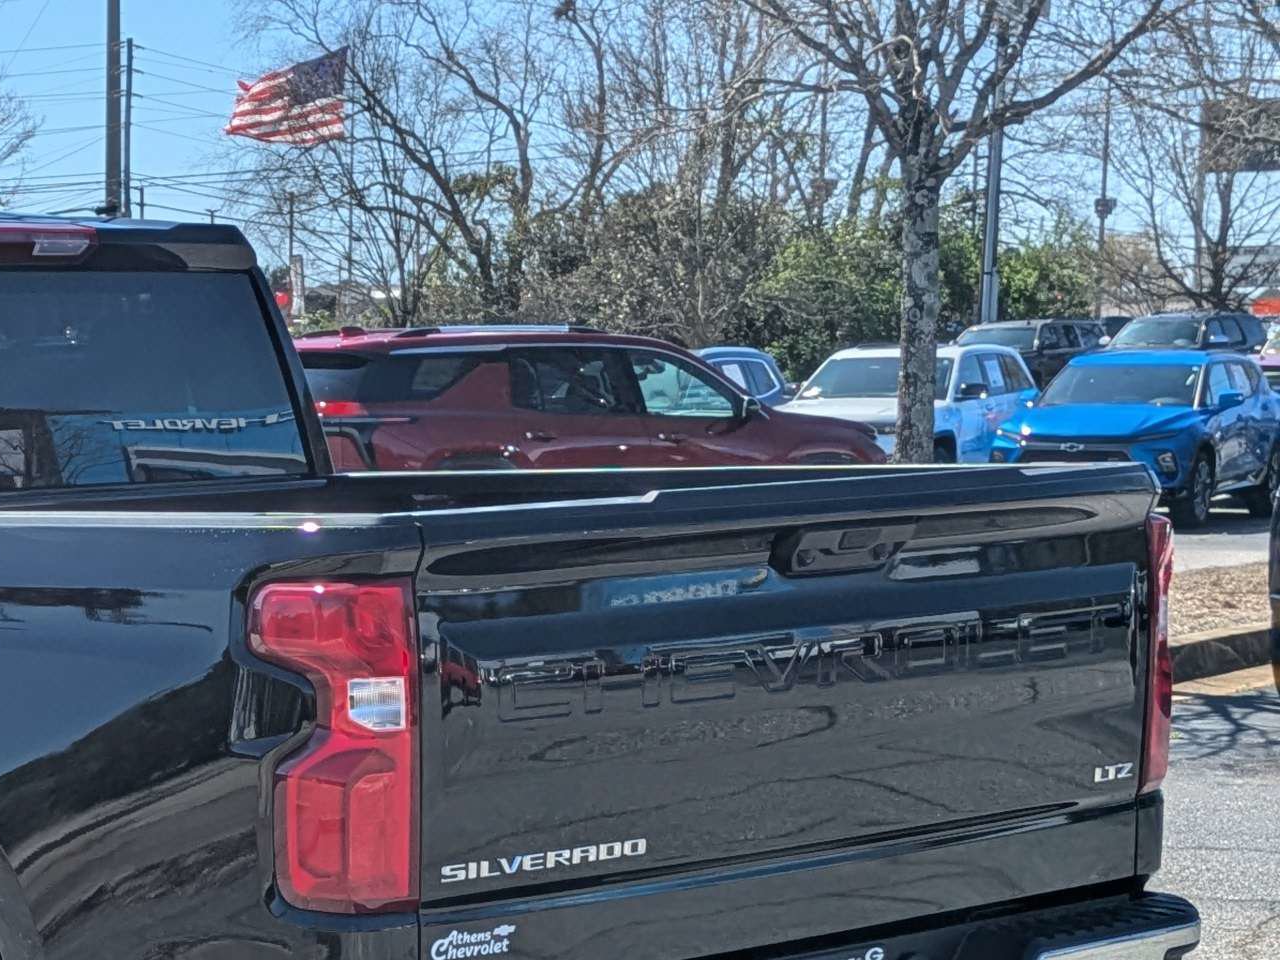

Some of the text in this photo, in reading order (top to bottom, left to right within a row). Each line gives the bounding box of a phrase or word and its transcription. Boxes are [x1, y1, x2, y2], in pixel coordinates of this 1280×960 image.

[497, 600, 1122, 722] CHEVROLET
[1094, 762, 1133, 783] LTZ
[440, 838, 647, 884] SILVERADO
[446, 929, 491, 946] Athens
